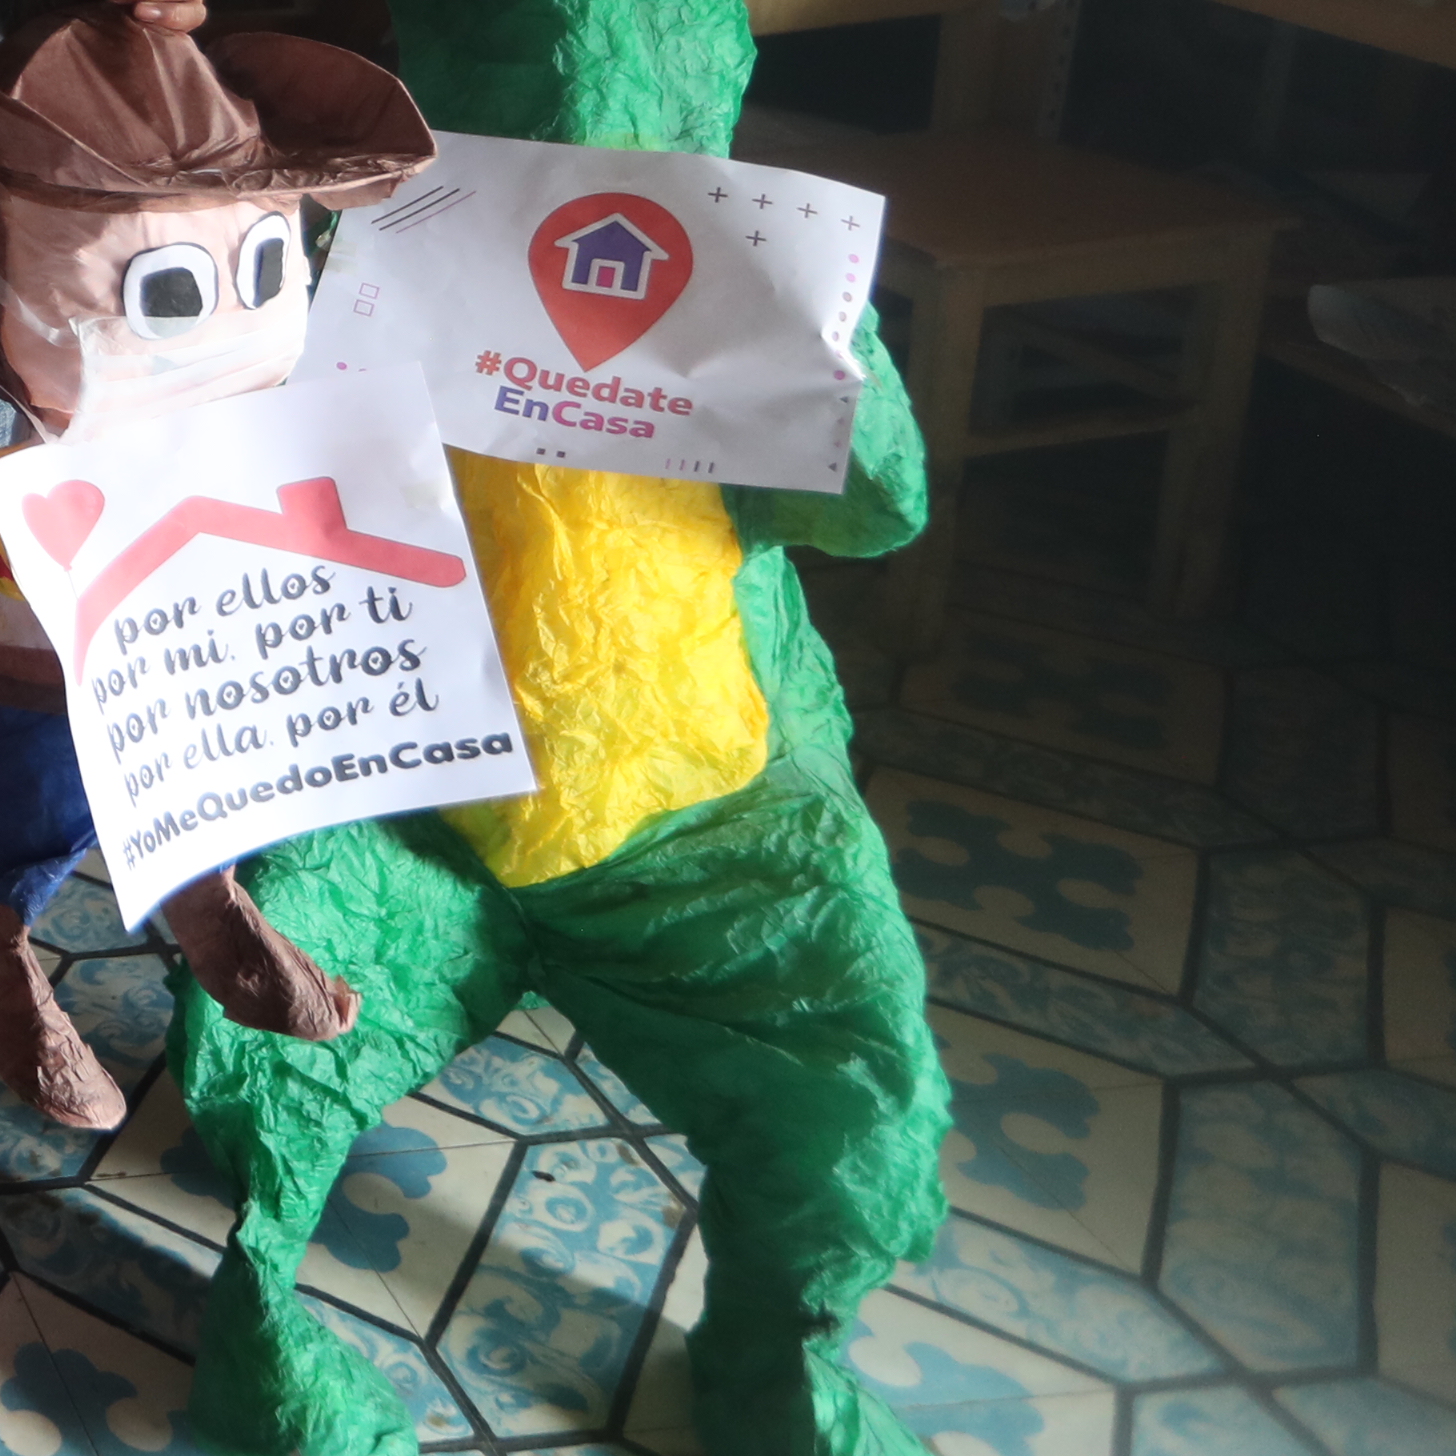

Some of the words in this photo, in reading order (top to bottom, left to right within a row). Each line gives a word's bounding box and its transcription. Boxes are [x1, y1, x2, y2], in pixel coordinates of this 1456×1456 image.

[474, 349, 694, 417] #Quedate
[494, 385, 656, 439] EnCasa
[91, 655, 150, 714] por
[255, 602, 351, 660] por
[359, 585, 413, 623] ti
[114, 596, 201, 655] por
[216, 565, 336, 617] ellos
[106, 697, 171, 764] por
[184, 638, 428, 720] nosotros
[123, 750, 174, 807] por
[286, 696, 374, 748] por
[389, 677, 440, 719] él
[122, 731, 515, 870] #YoMeQuedoEnCasa
